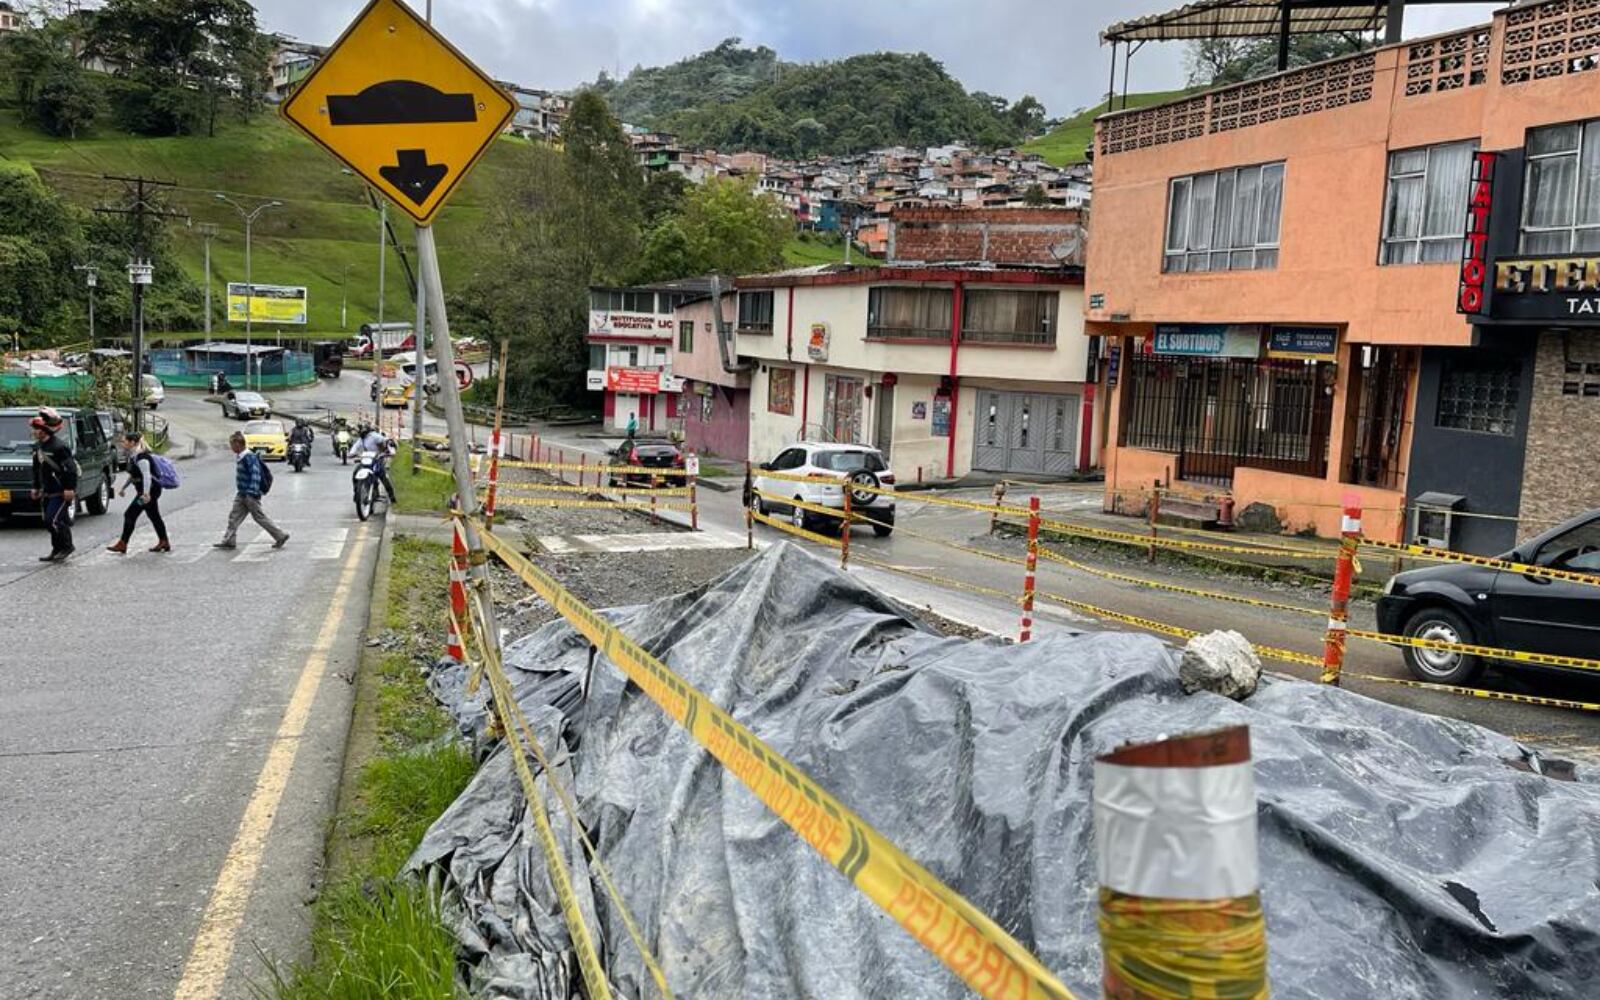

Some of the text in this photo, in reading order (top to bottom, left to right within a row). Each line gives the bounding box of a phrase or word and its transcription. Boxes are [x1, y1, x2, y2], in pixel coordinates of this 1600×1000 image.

[1461, 152, 1496, 312] TATTOO
[1158, 333, 1221, 353] EL SURTIDOR
[764, 779, 794, 819] NO
[789, 796, 845, 857] PASE
